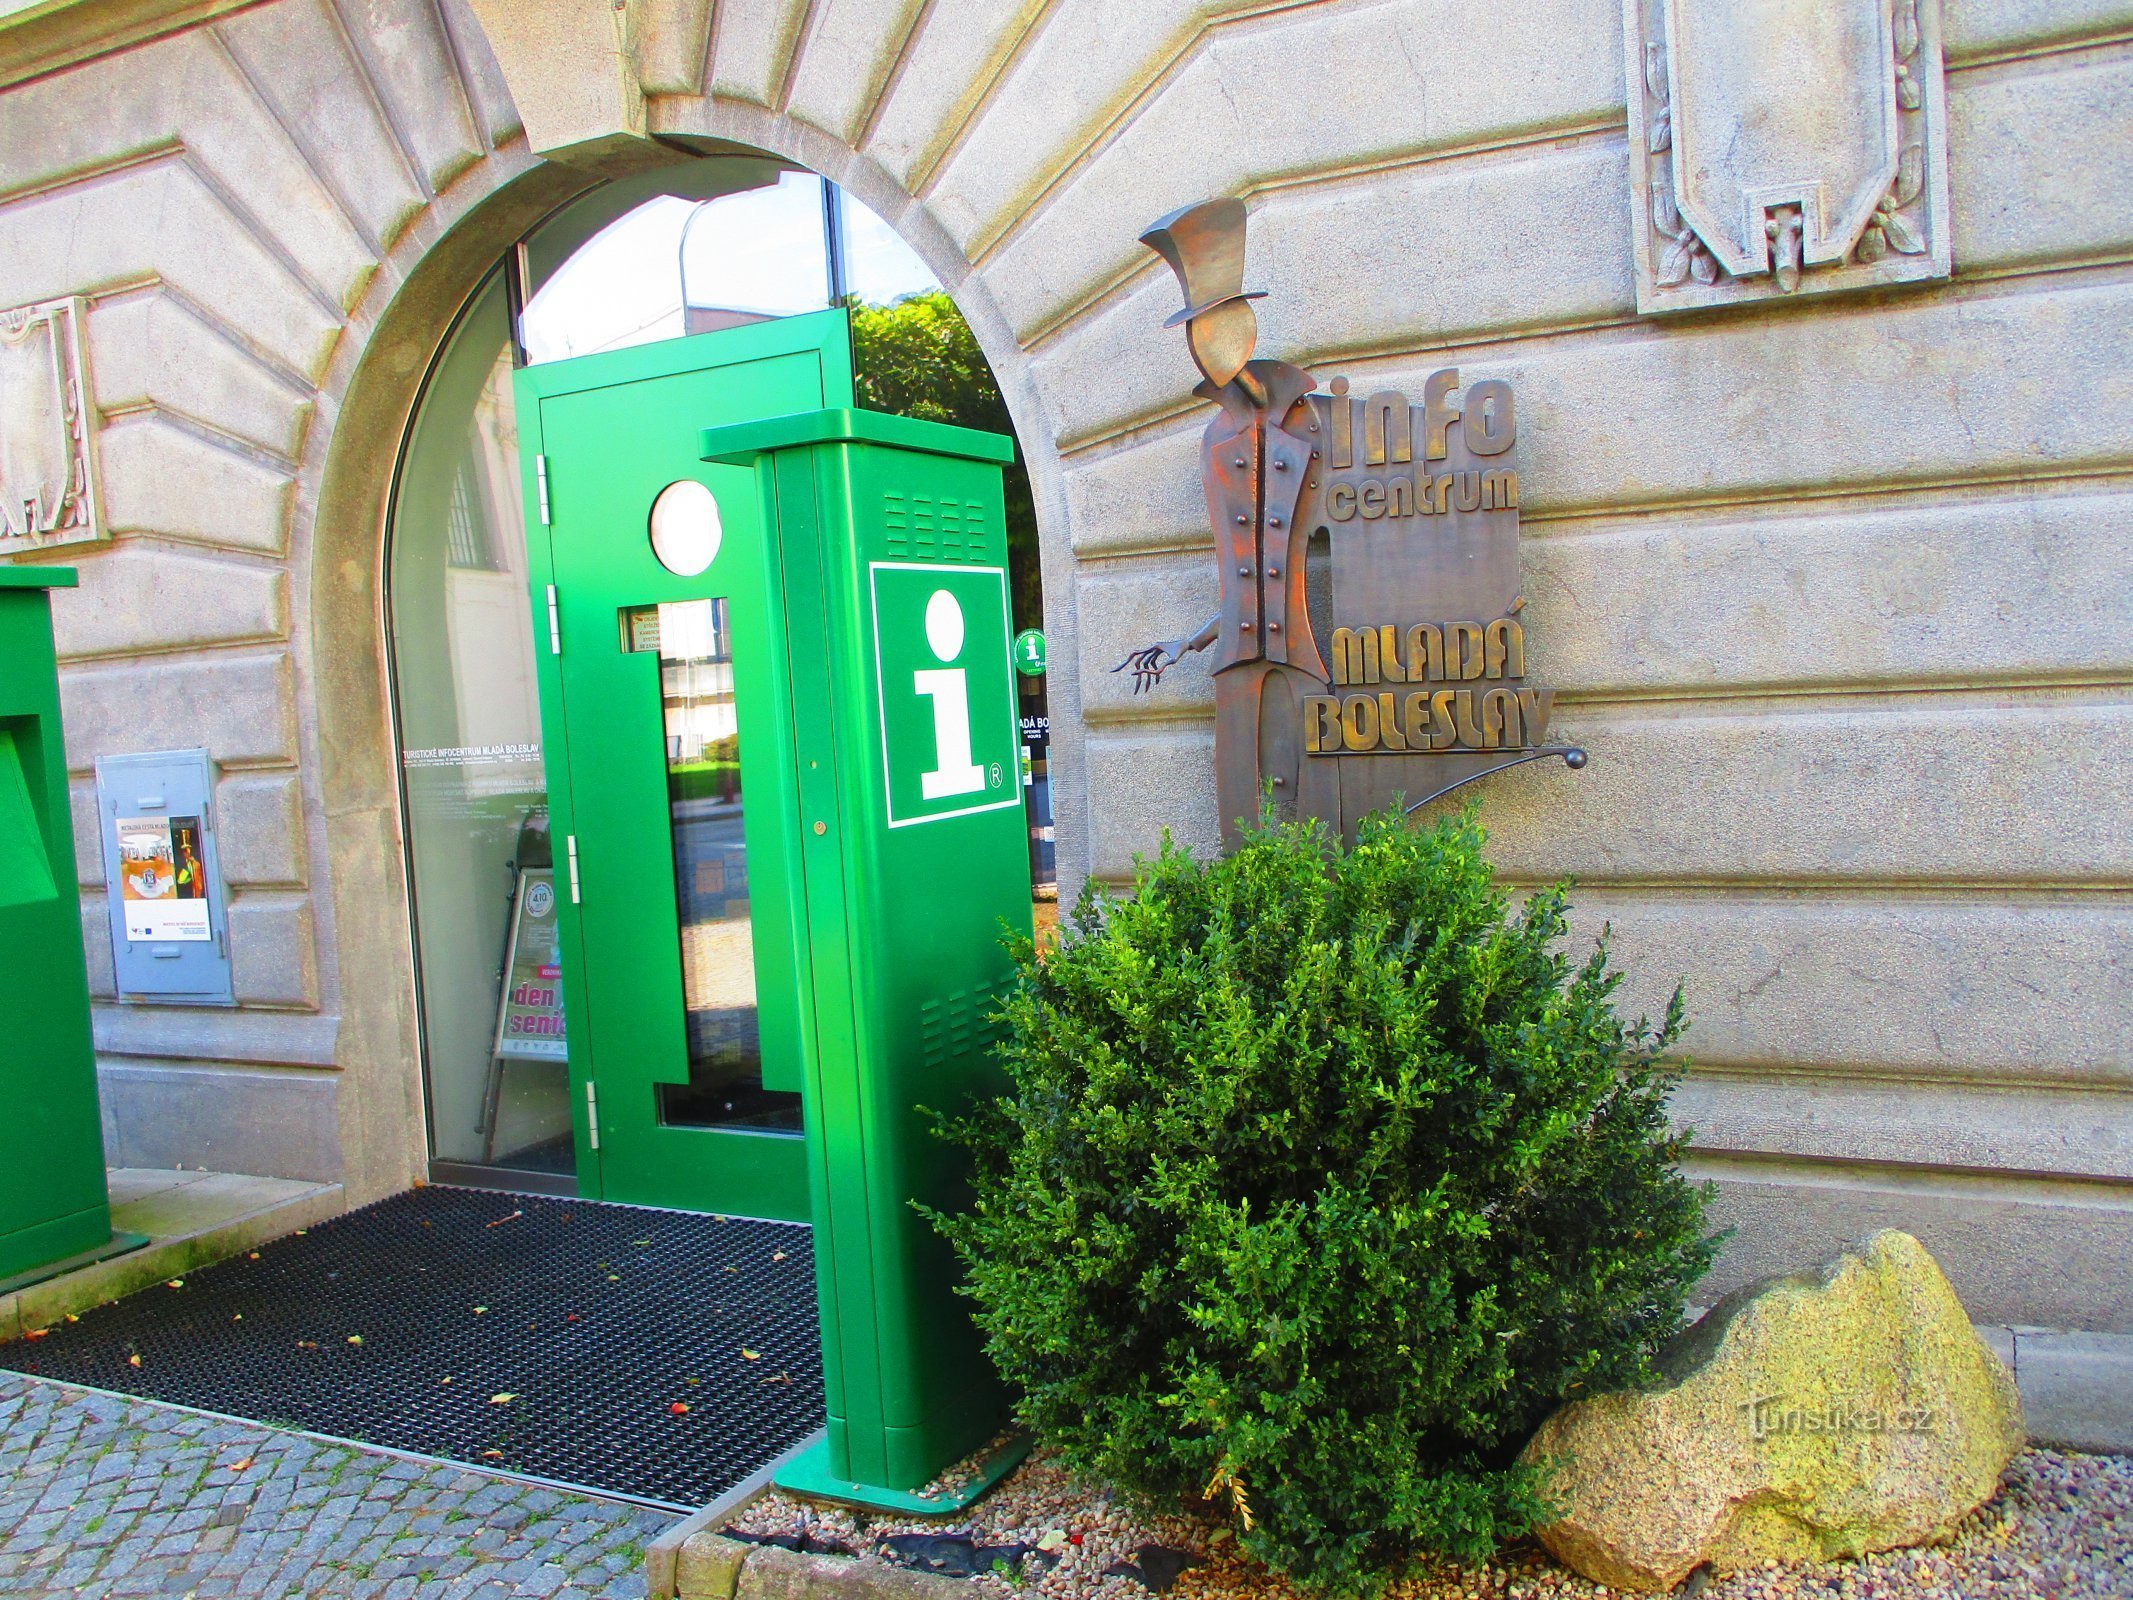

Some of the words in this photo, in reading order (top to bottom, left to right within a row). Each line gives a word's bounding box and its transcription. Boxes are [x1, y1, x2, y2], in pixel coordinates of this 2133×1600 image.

[1329, 367, 1516, 469] info
[1326, 460, 1518, 522] centrum
[1332, 596, 1526, 685] MLADÁ
[403, 747, 437, 759] TURISTICKÉ
[438, 746, 481, 758] INFOCENTRUM
[483, 744, 505, 756] MLADÁ
[506, 743, 539, 754] BOLESLAV
[1303, 687, 1556, 752] BOLESLAV
[514, 982, 554, 1007] den
